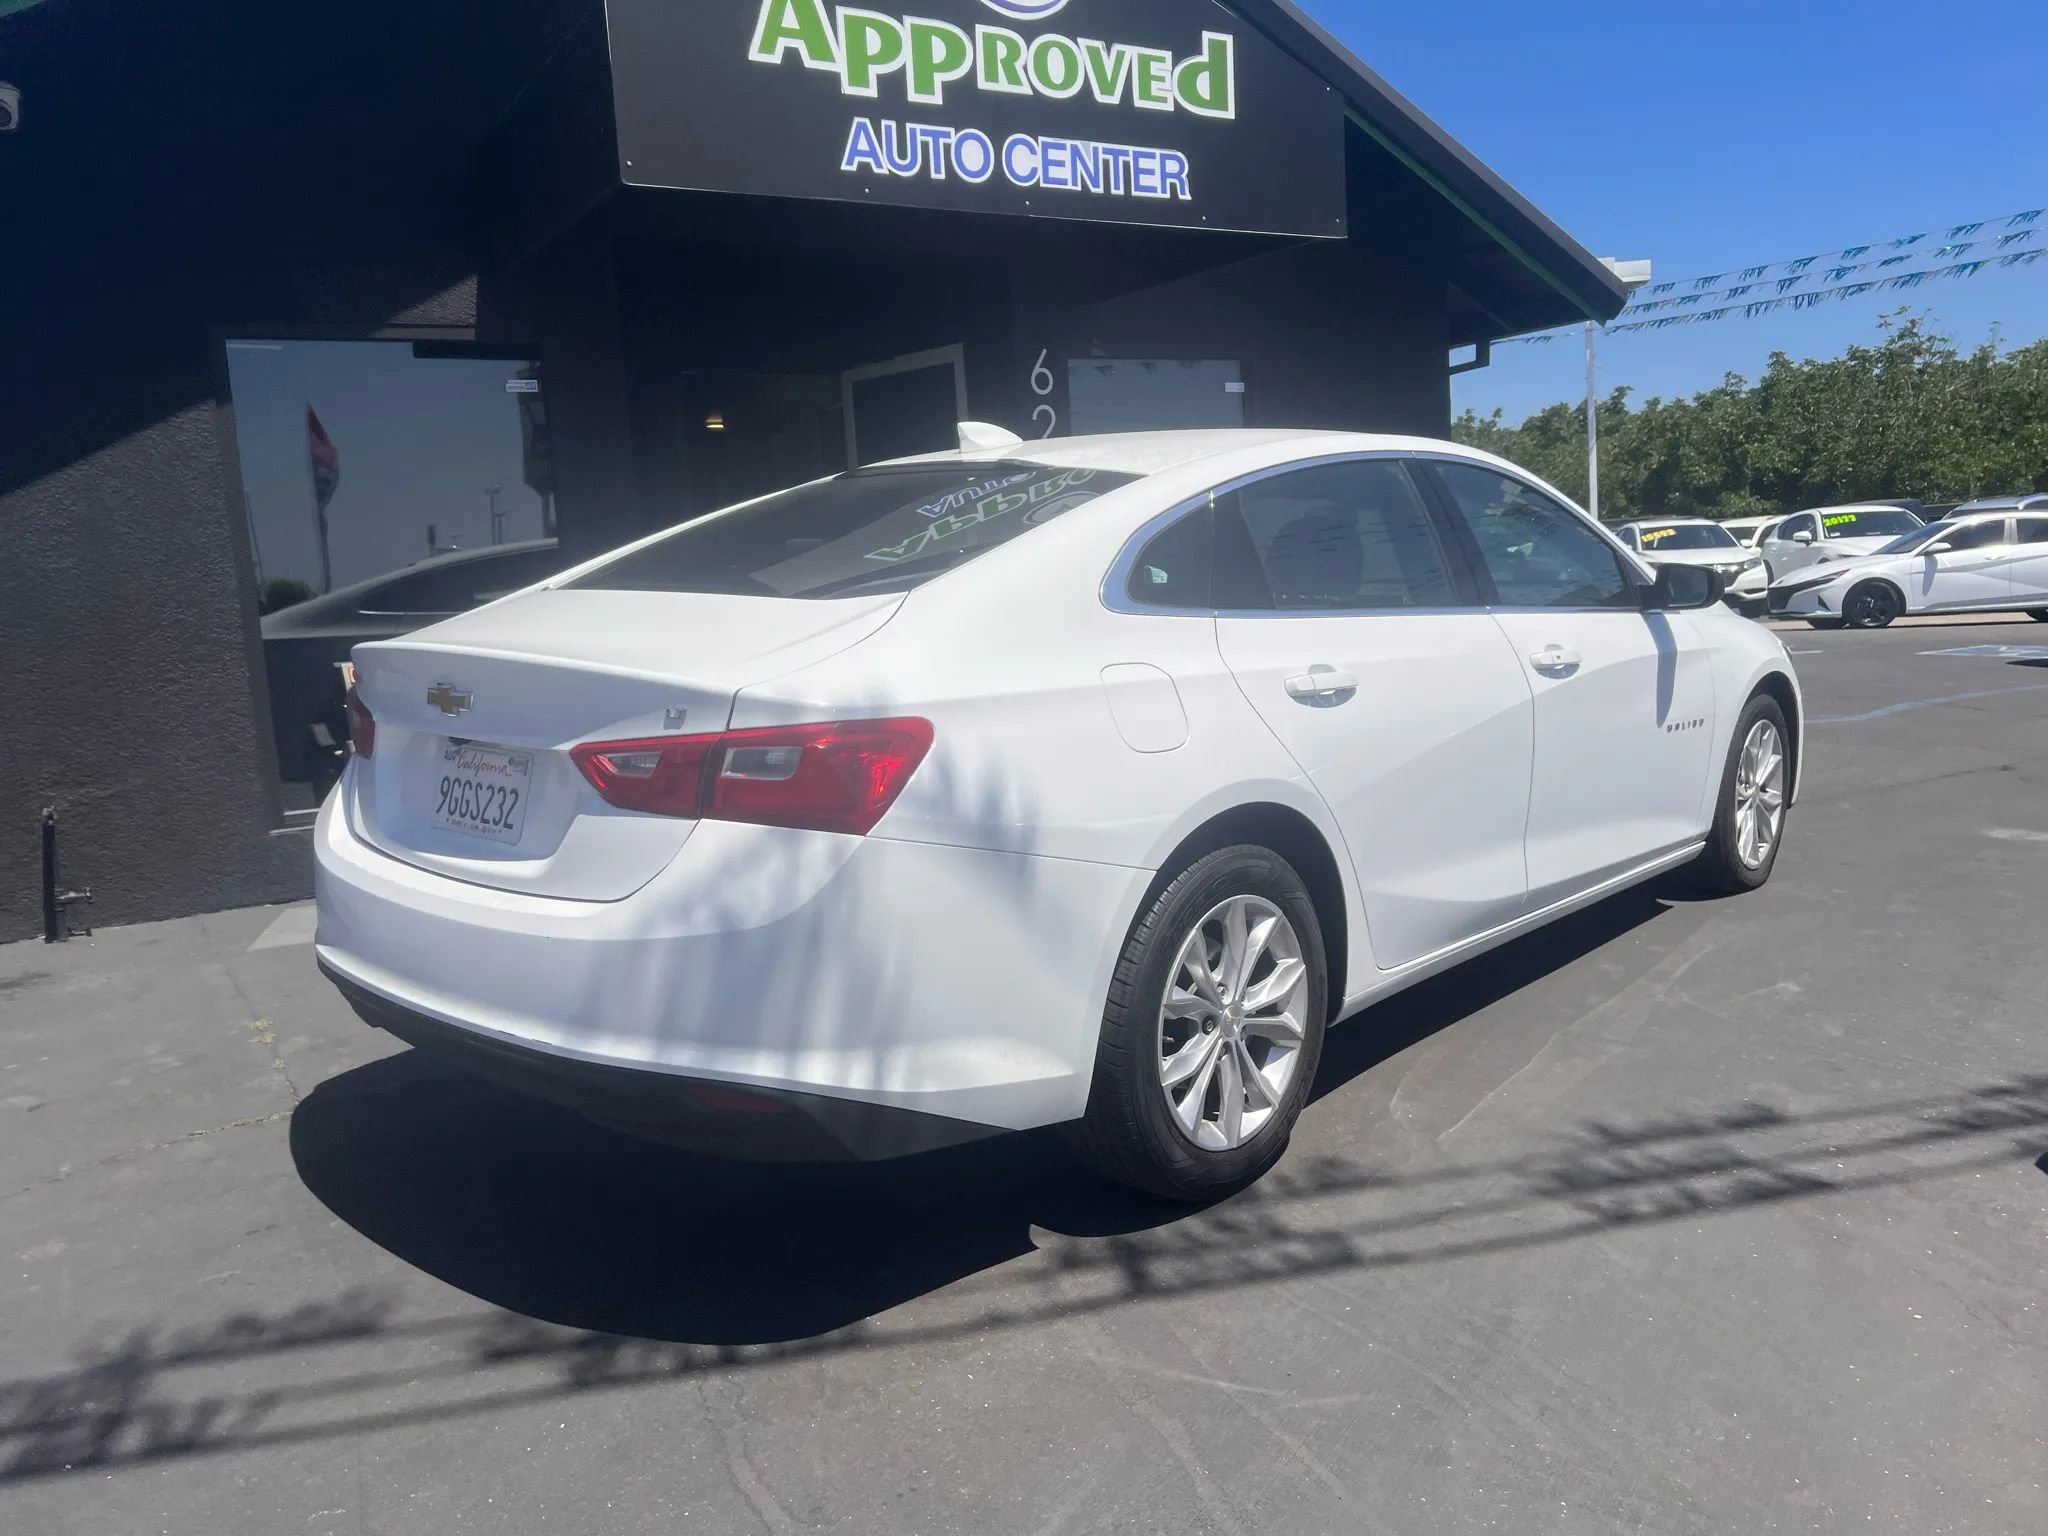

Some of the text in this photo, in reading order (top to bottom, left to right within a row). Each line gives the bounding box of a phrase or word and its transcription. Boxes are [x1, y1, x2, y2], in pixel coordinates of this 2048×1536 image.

[841, 116, 1192, 200] AUTO CENTER
[436, 776, 519, 830] 9GGS232
